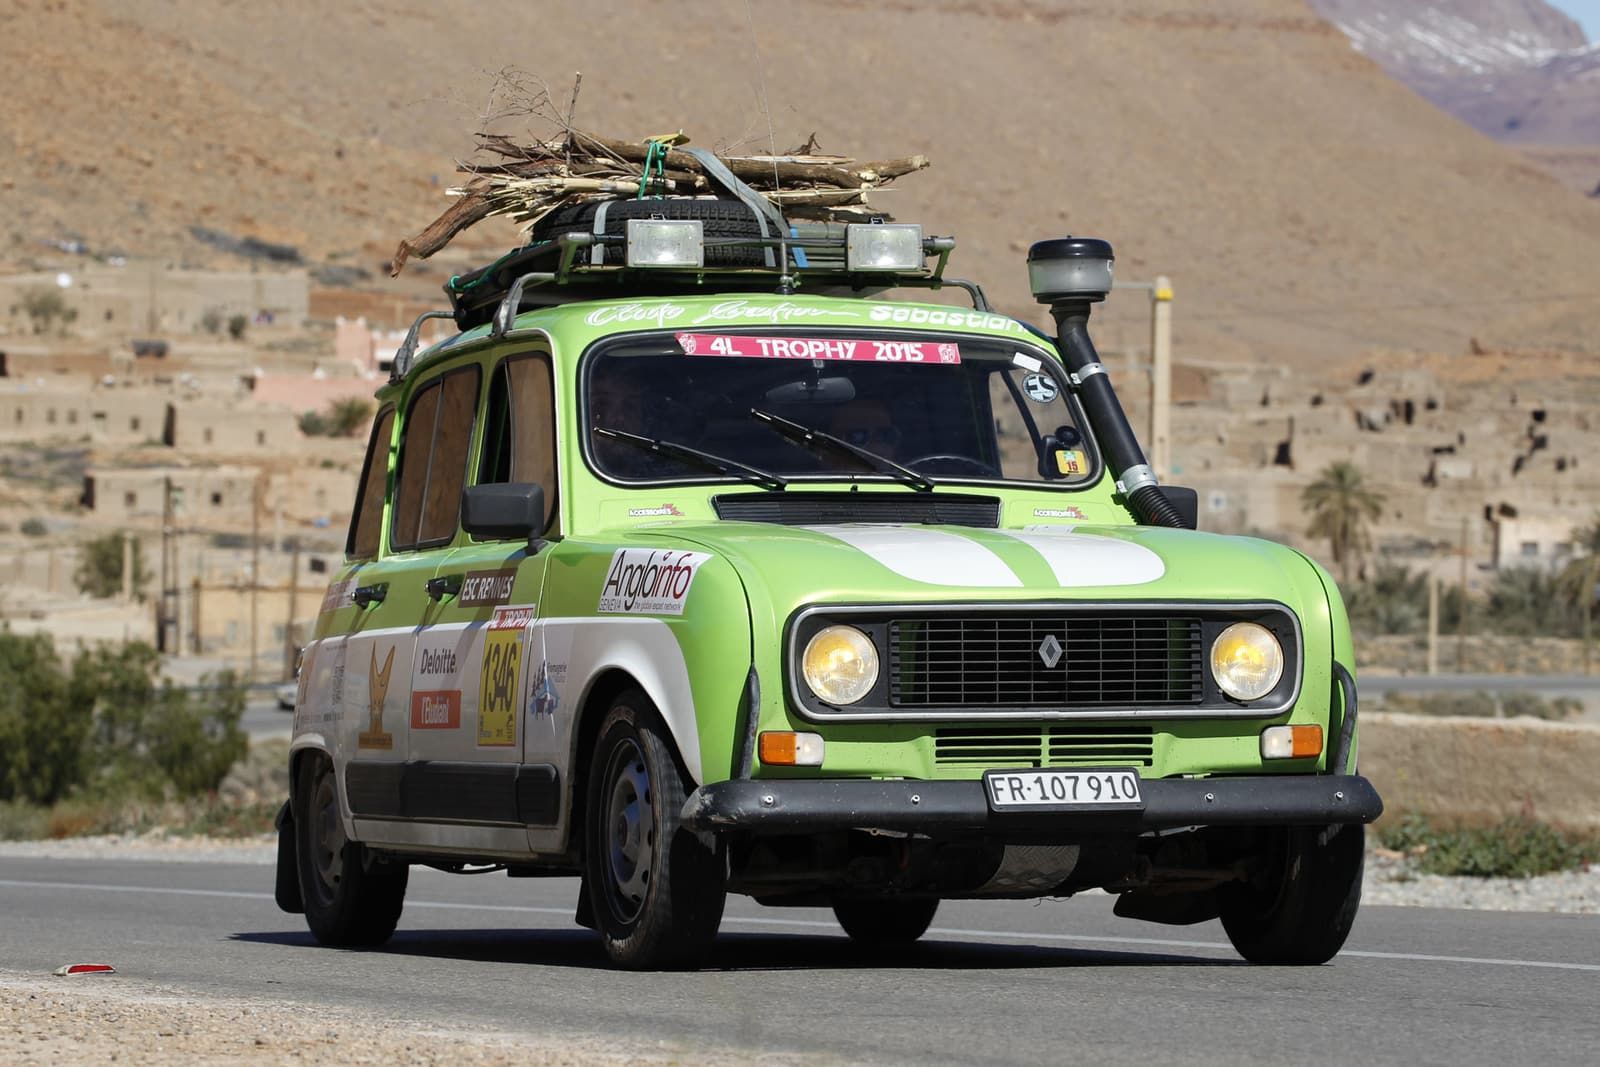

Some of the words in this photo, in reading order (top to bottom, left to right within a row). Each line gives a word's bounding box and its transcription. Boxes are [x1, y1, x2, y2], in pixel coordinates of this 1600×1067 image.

[710, 337, 742, 356] 4L
[756, 339, 856, 360] TROPHY
[871, 341, 924, 362] 2015
[461, 578, 480, 601] ESC
[477, 575, 514, 600] RENNES
[602, 550, 692, 611] Angloinfo
[482, 642, 517, 713] 1346
